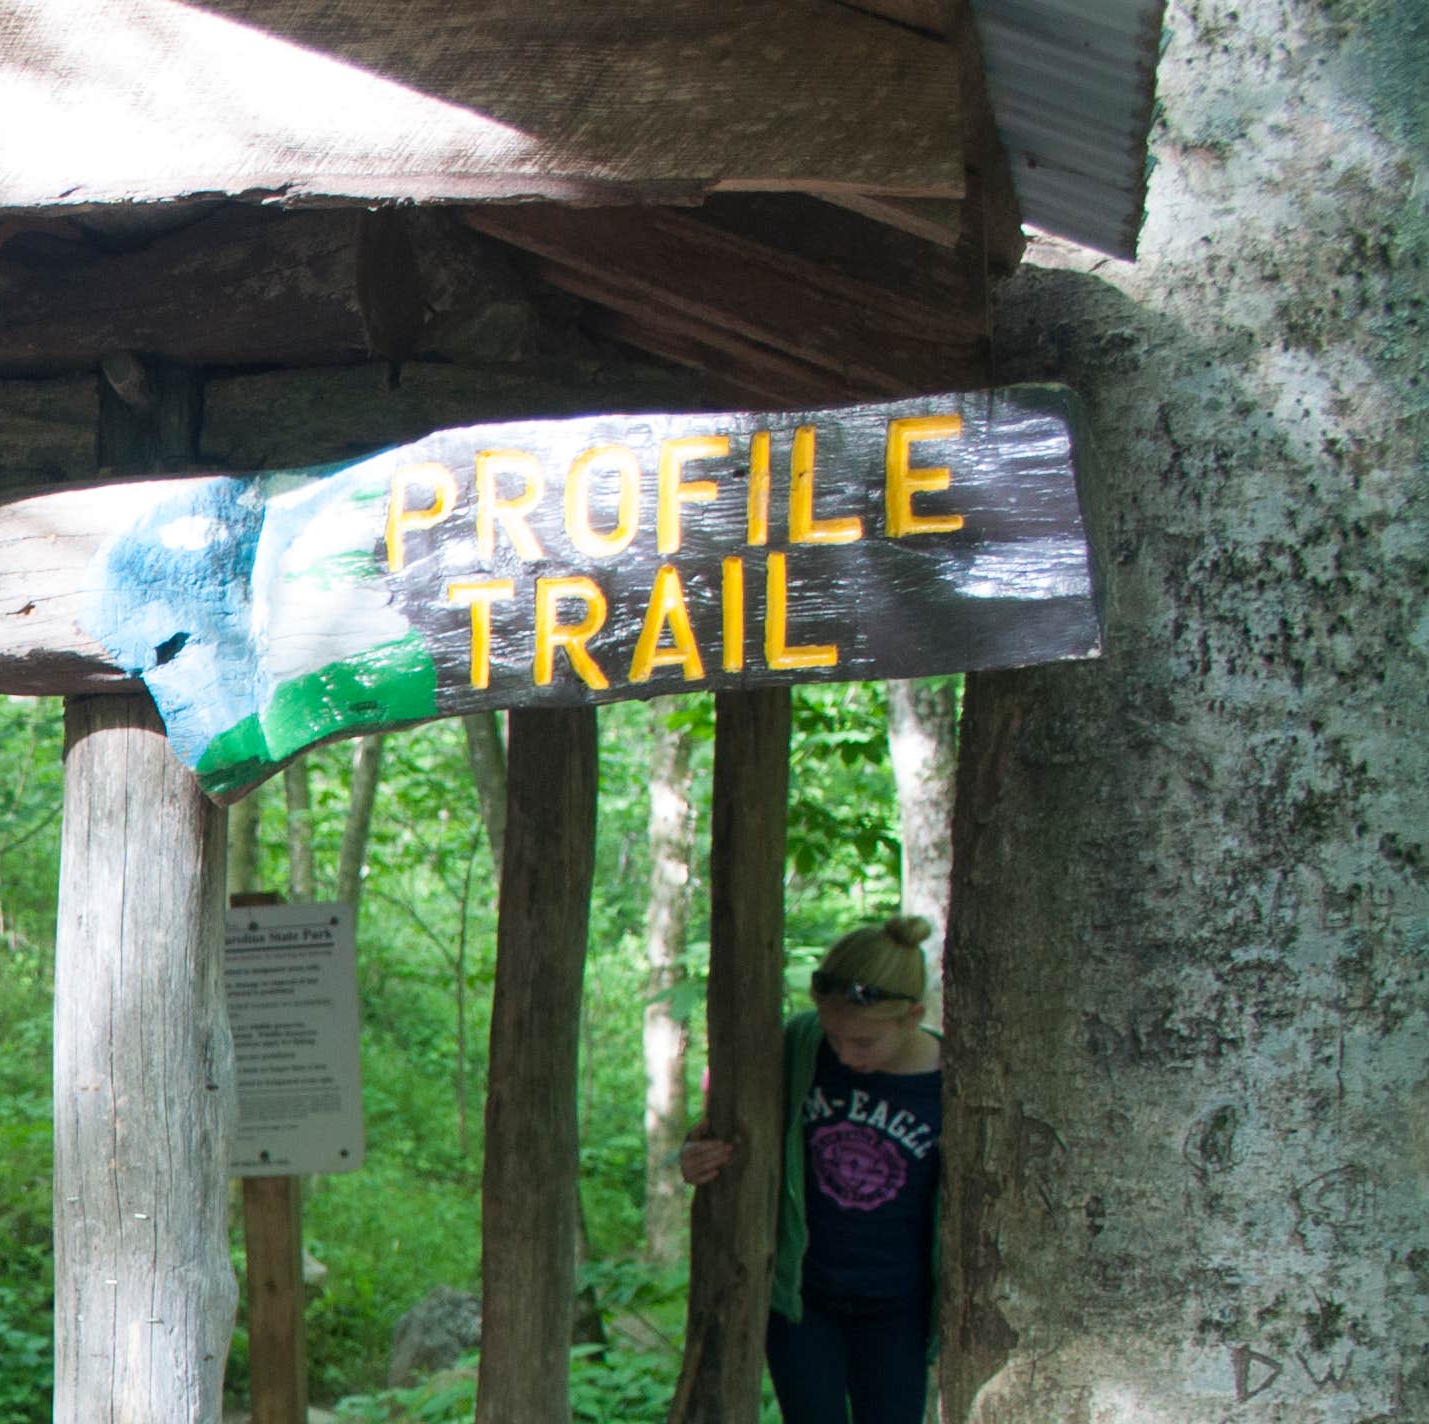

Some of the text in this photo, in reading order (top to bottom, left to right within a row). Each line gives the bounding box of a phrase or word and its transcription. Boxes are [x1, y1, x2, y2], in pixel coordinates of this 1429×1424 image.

[385, 414, 965, 573] PROFILE
[448, 551, 839, 690] TRAIL
[303, 928, 333, 941] Park
